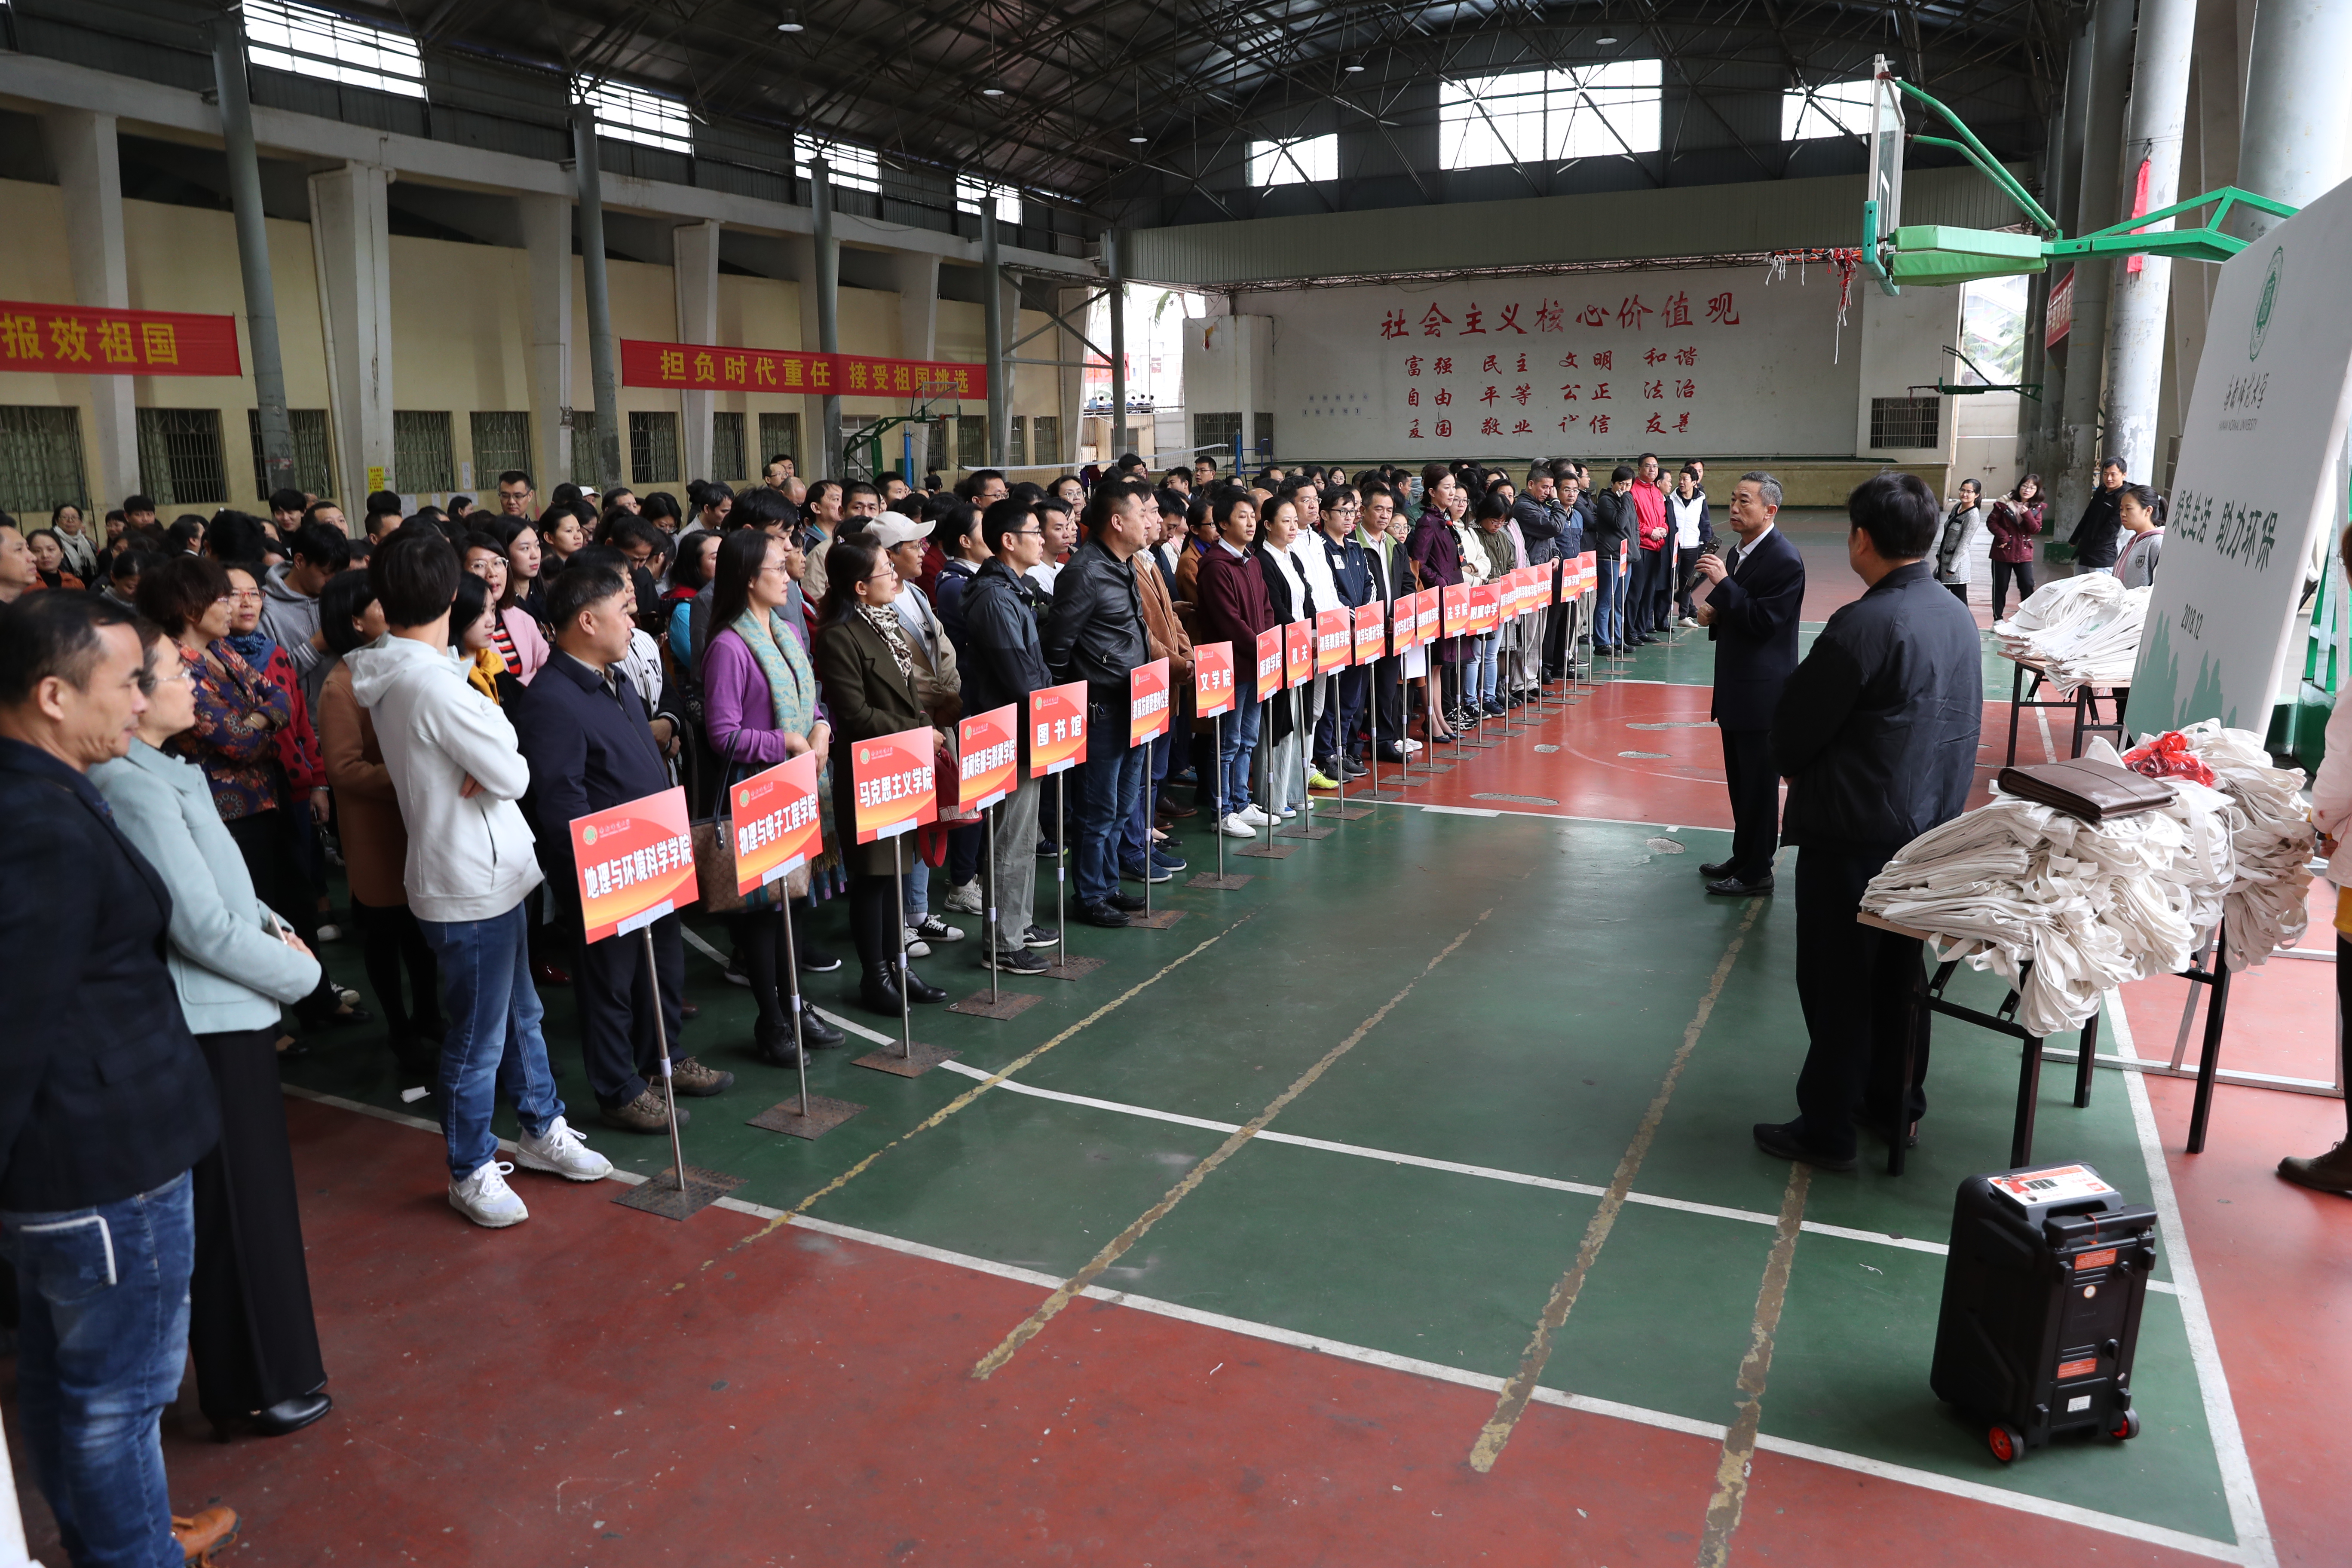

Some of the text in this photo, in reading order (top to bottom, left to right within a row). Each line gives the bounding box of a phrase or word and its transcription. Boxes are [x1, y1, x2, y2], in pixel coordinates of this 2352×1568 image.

[1381, 291, 1740, 340] 社会主义核心价值观
[0, 312, 178, 365] 报效祖国
[661, 349, 968, 393] 担负时代重任 接受祖国挑选
[1405, 346, 1698, 377] 富强 民主 文明 和谐
[1407, 379, 1695, 407] 自由 平等 公正 法治
[1481, 416, 1532, 435] 敬业
[1646, 412, 1691, 434] 友善
[2172, 489, 2278, 573] 绿色生活 助力环保
[1564, 574, 1580, 588] 音乐学院
[1418, 606, 1439, 627] 继续教育学院
[1447, 603, 1467, 620] 法学院
[1470, 602, 1498, 620] 附属中学
[2181, 603, 2203, 640] 2018.12
[1357, 623, 1384, 646] 数学与统计学院
[1395, 615, 1415, 637] 化学与化工学院
[1292, 644, 1308, 665] 机关
[1320, 629, 1350, 652] 初等教育学院
[1260, 651, 1281, 678] 旅游学院
[1200, 668, 1231, 692] 文学院
[1037, 714, 1082, 747] 图书馆
[962, 738, 1015, 781] 新闻传播与影视学院
[859, 765, 933, 808] 马克思主义学院
[738, 793, 817, 857] 物理与电子工程学院
[584, 833, 692, 899] 地理与环境科学学院
